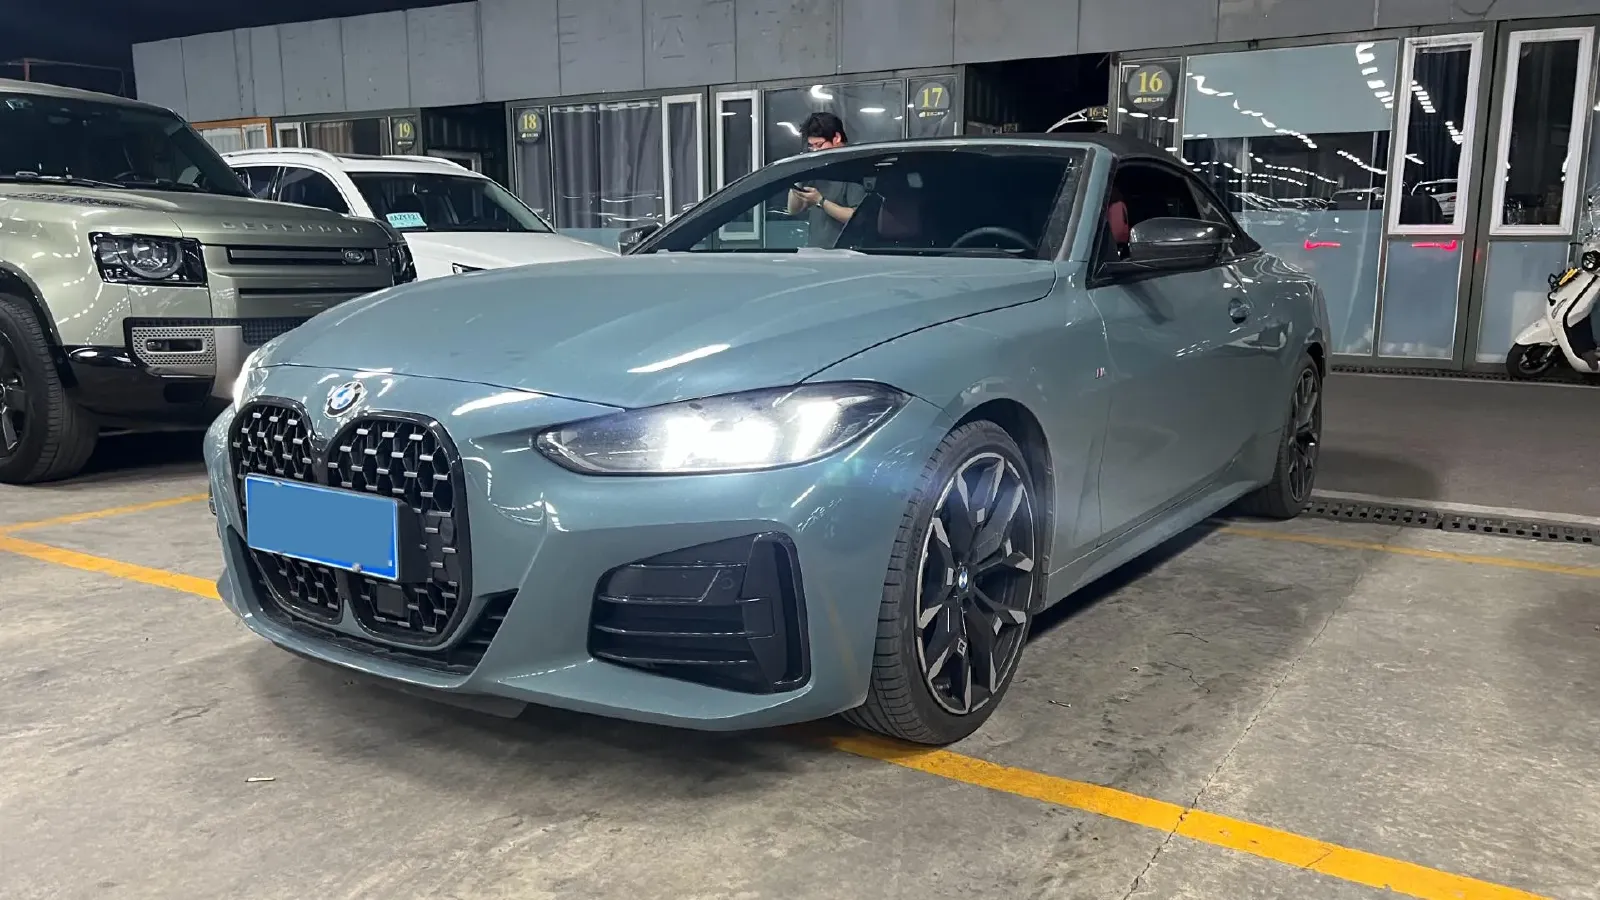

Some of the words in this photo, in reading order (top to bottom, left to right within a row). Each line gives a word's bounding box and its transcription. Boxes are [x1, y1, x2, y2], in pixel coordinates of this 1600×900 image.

[1137, 70, 1163, 92] 16
[921, 87, 943, 107] 17
[399, 122, 411, 138] 19
[523, 113, 537, 130] 18
